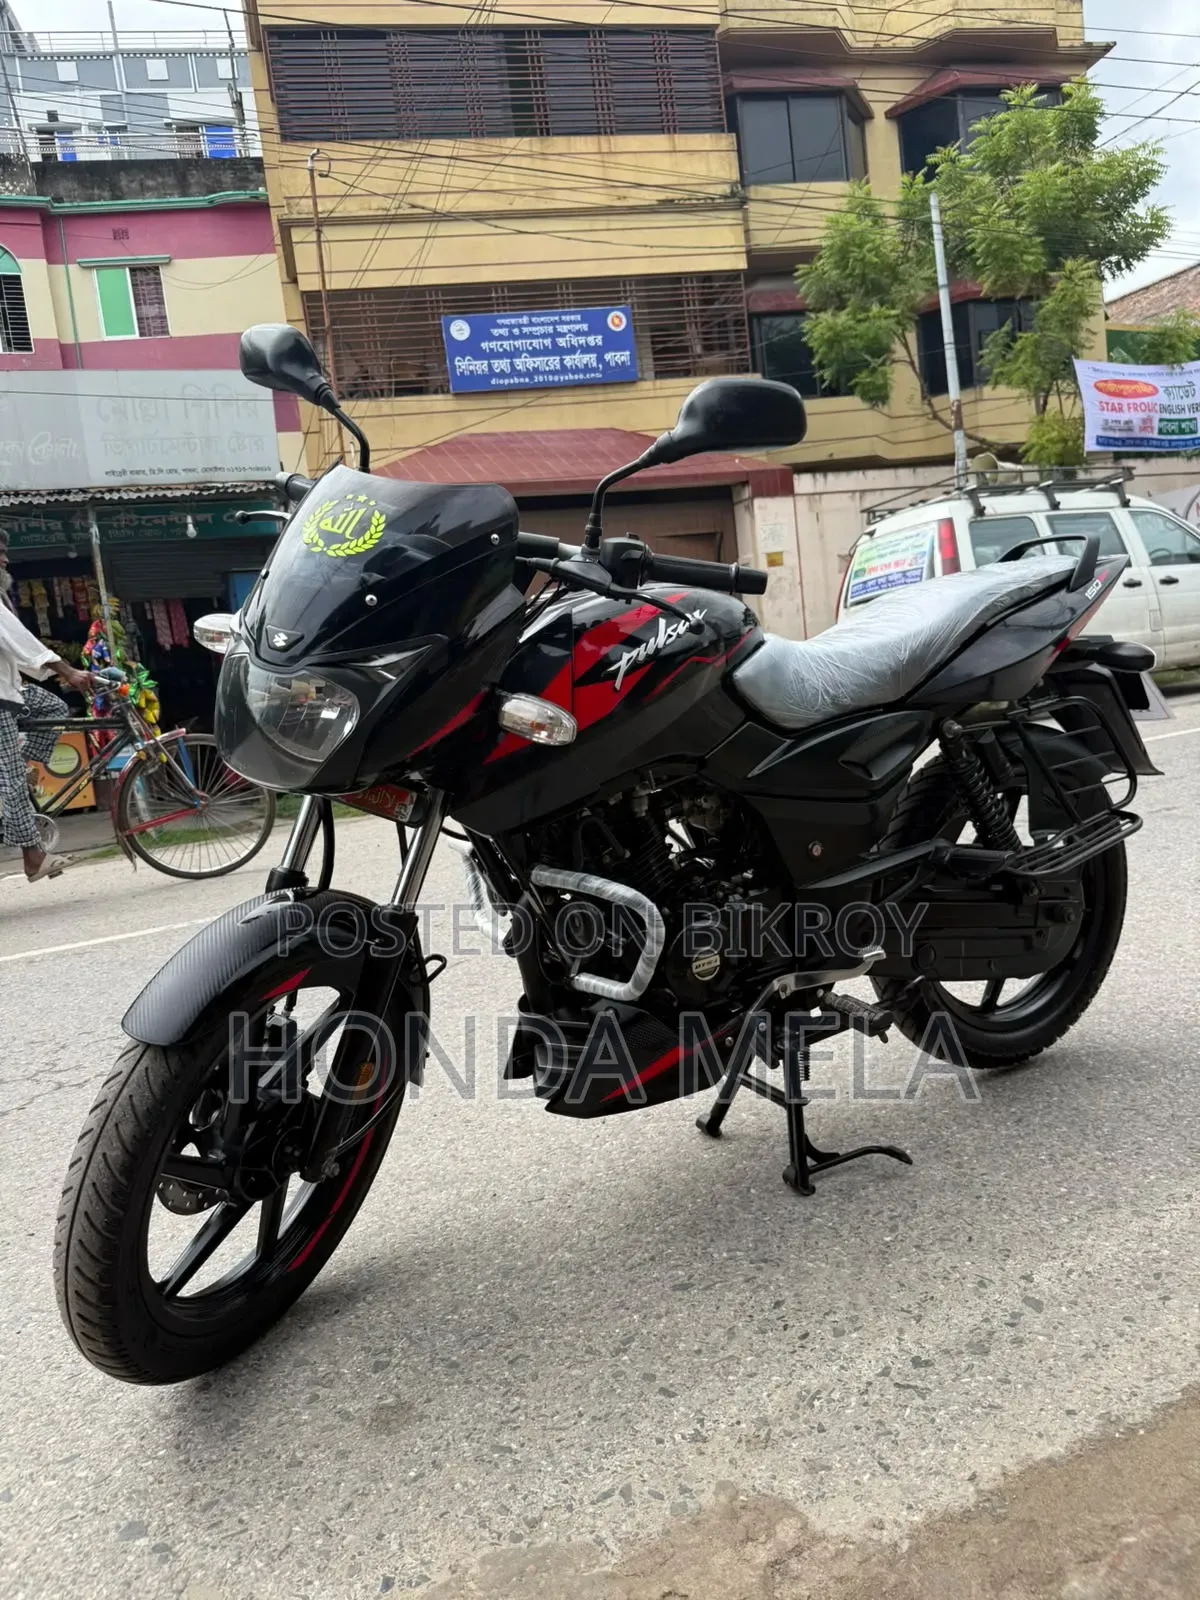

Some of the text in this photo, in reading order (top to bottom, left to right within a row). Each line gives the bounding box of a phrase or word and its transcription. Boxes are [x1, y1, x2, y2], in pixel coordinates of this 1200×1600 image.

[531, 315, 560, 324] বাংলাদেশ
[561, 314, 582, 322] সরকার
[490, 327, 510, 337] তথ্য
[522, 324, 554, 336] সম্প্রচার
[480, 333, 603, 354] গণযোগাযোগ অধিদপ্তর
[454, 356, 489, 376] সিনিয়র
[490, 357, 511, 374] তথ্য
[513, 352, 561, 373] অফিসারের
[604, 350, 631, 367] পাবনা
[1098, 401, 1124, 413] STAR
[1159, 403, 1186, 415] ENGLISH
[1085, 579, 1102, 600] 150
